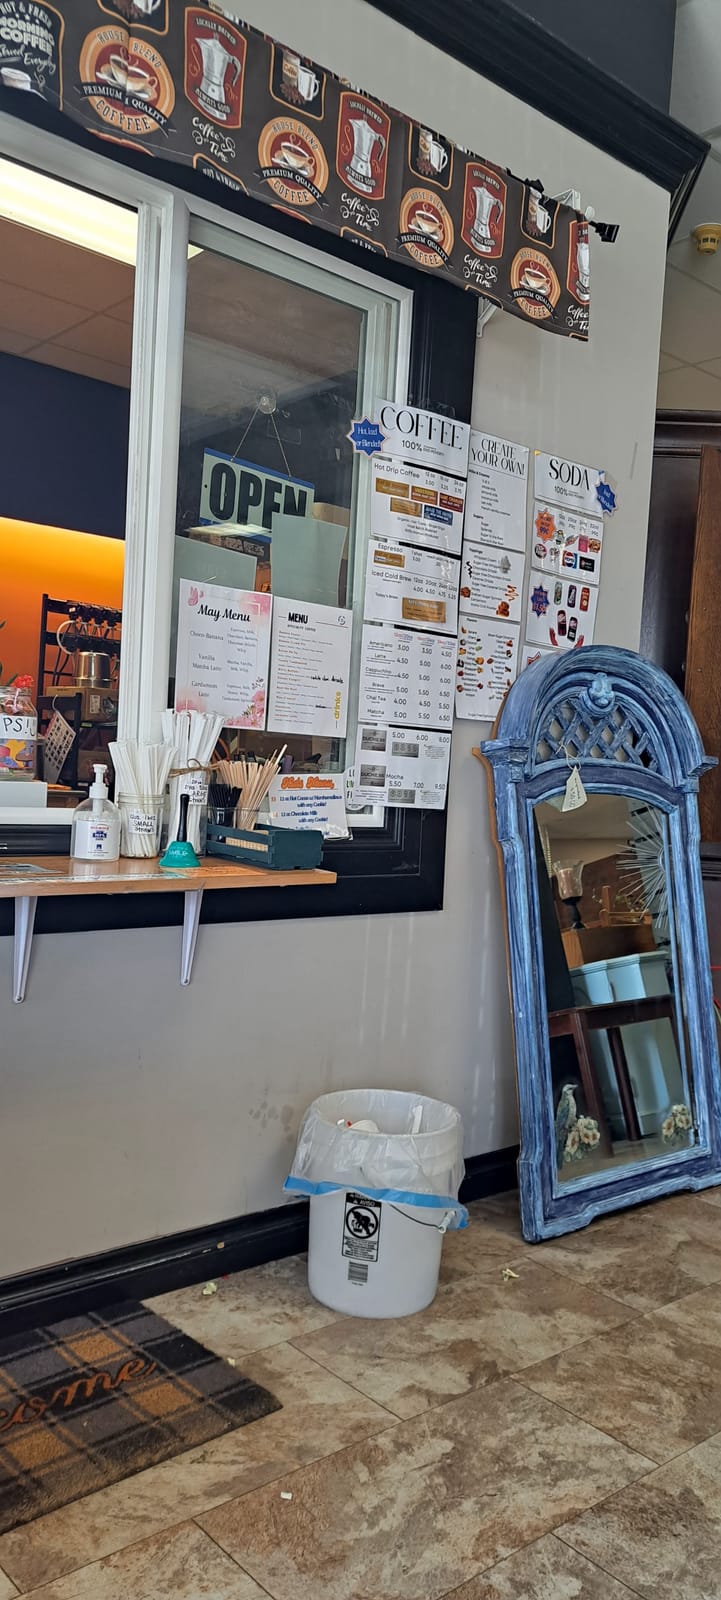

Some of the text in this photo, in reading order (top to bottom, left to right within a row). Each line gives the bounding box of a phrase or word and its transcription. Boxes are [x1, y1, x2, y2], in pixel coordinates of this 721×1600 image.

[97, 30, 125, 46] HOUSE
[83, 86, 167, 125] PREMIUM QUALITY
[192, 116, 220, 140] Coffee
[262, 168, 322, 200] PREMIUM QUALITY
[273, 180, 310, 203] COFFEE
[341, 192, 368, 213] Coffee
[401, 235, 449, 262] PREMIUM QUALITY
[409, 245, 440, 266] COFFEE
[464, 253, 487, 271] Coffee
[513, 290, 555, 312] PREMIUM QUALITY
[521, 298, 548, 317] COFFEE
[381, 406, 464, 450] COFFEE
[402, 439, 423, 452] 100%
[481, 438, 517, 460] CREATE
[374, 463, 420, 479] Hot Drip Coffee
[472, 447, 525, 475] YOUR OWN!
[549, 458, 590, 491] SODA
[209, 462, 308, 531] OPEN
[378, 542, 404, 553] Espresso
[371, 569, 384, 578] Iced
[385, 571, 399, 581] Cold
[399, 575, 412, 583] Brew
[197, 604, 252, 623] May Menu
[288, 612, 309, 625] MENU
[370, 640, 393, 649] Americano
[198, 654, 215, 662] Vanilla
[333, 690, 343, 721] drinks
